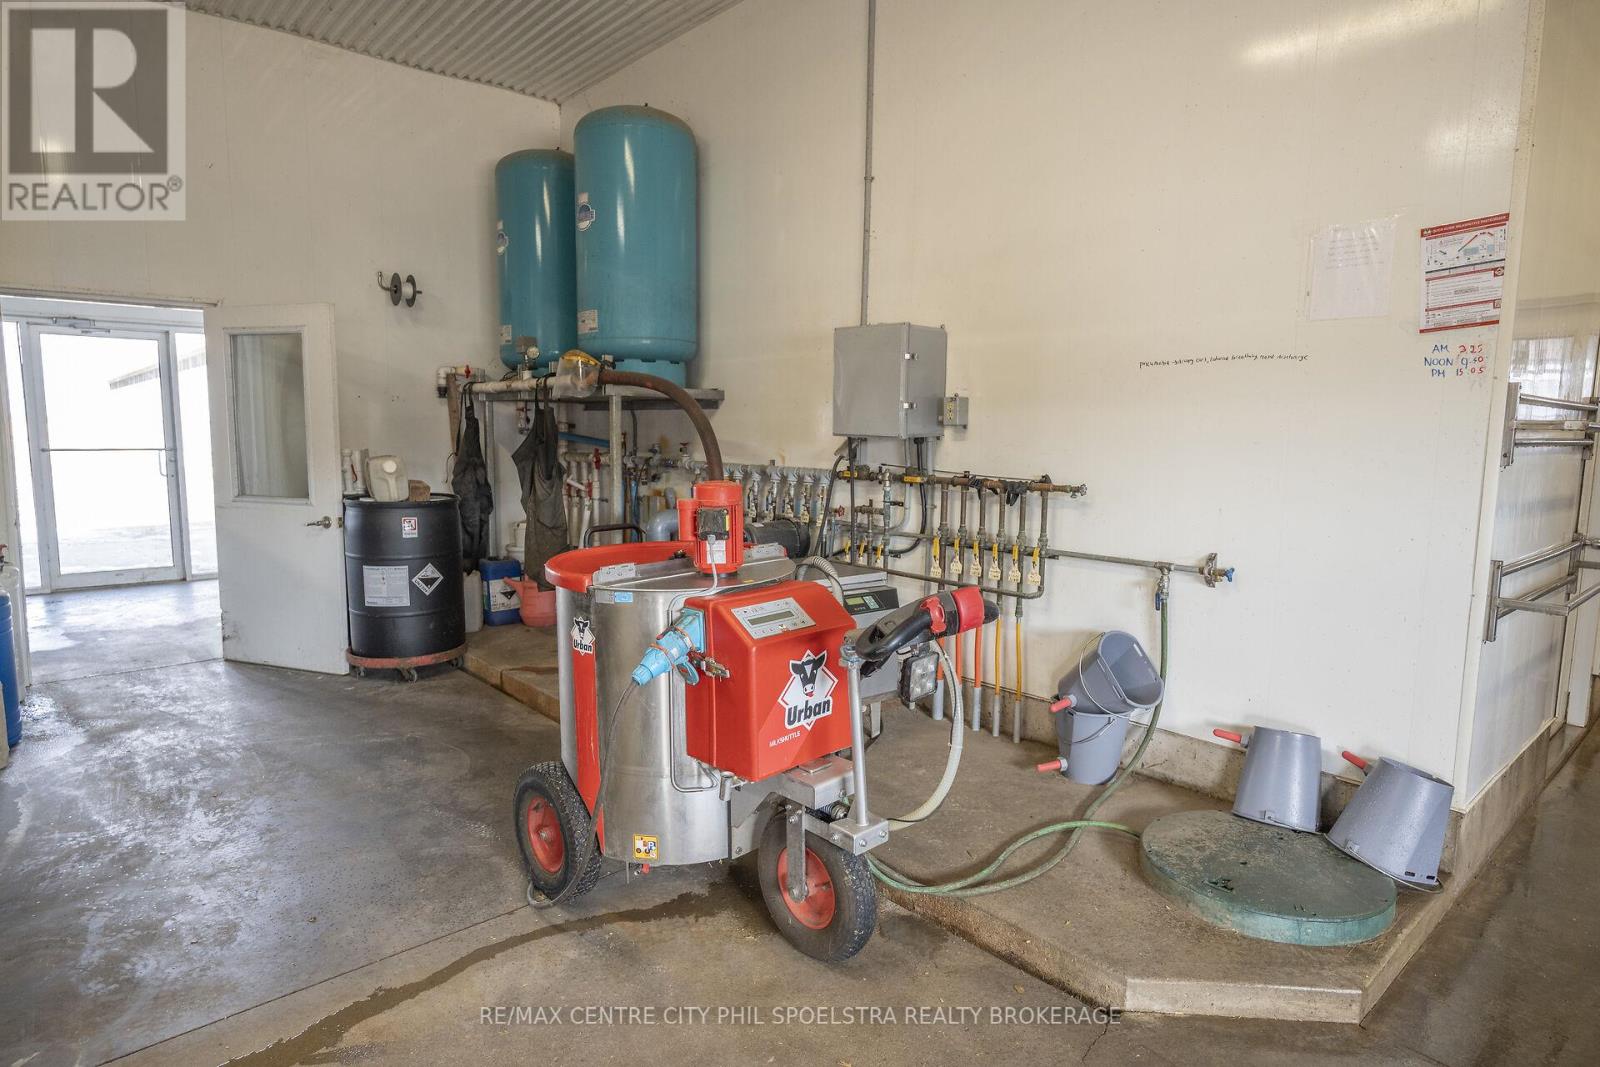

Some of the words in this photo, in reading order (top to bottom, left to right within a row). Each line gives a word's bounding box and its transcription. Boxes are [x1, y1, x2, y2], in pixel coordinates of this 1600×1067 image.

[1431, 344, 1450, 354] AM
[1424, 356, 1454, 367] NOON
[1431, 368, 1446, 378] PM
[573, 638, 592, 652] Urban
[786, 698, 831, 726] Urban
